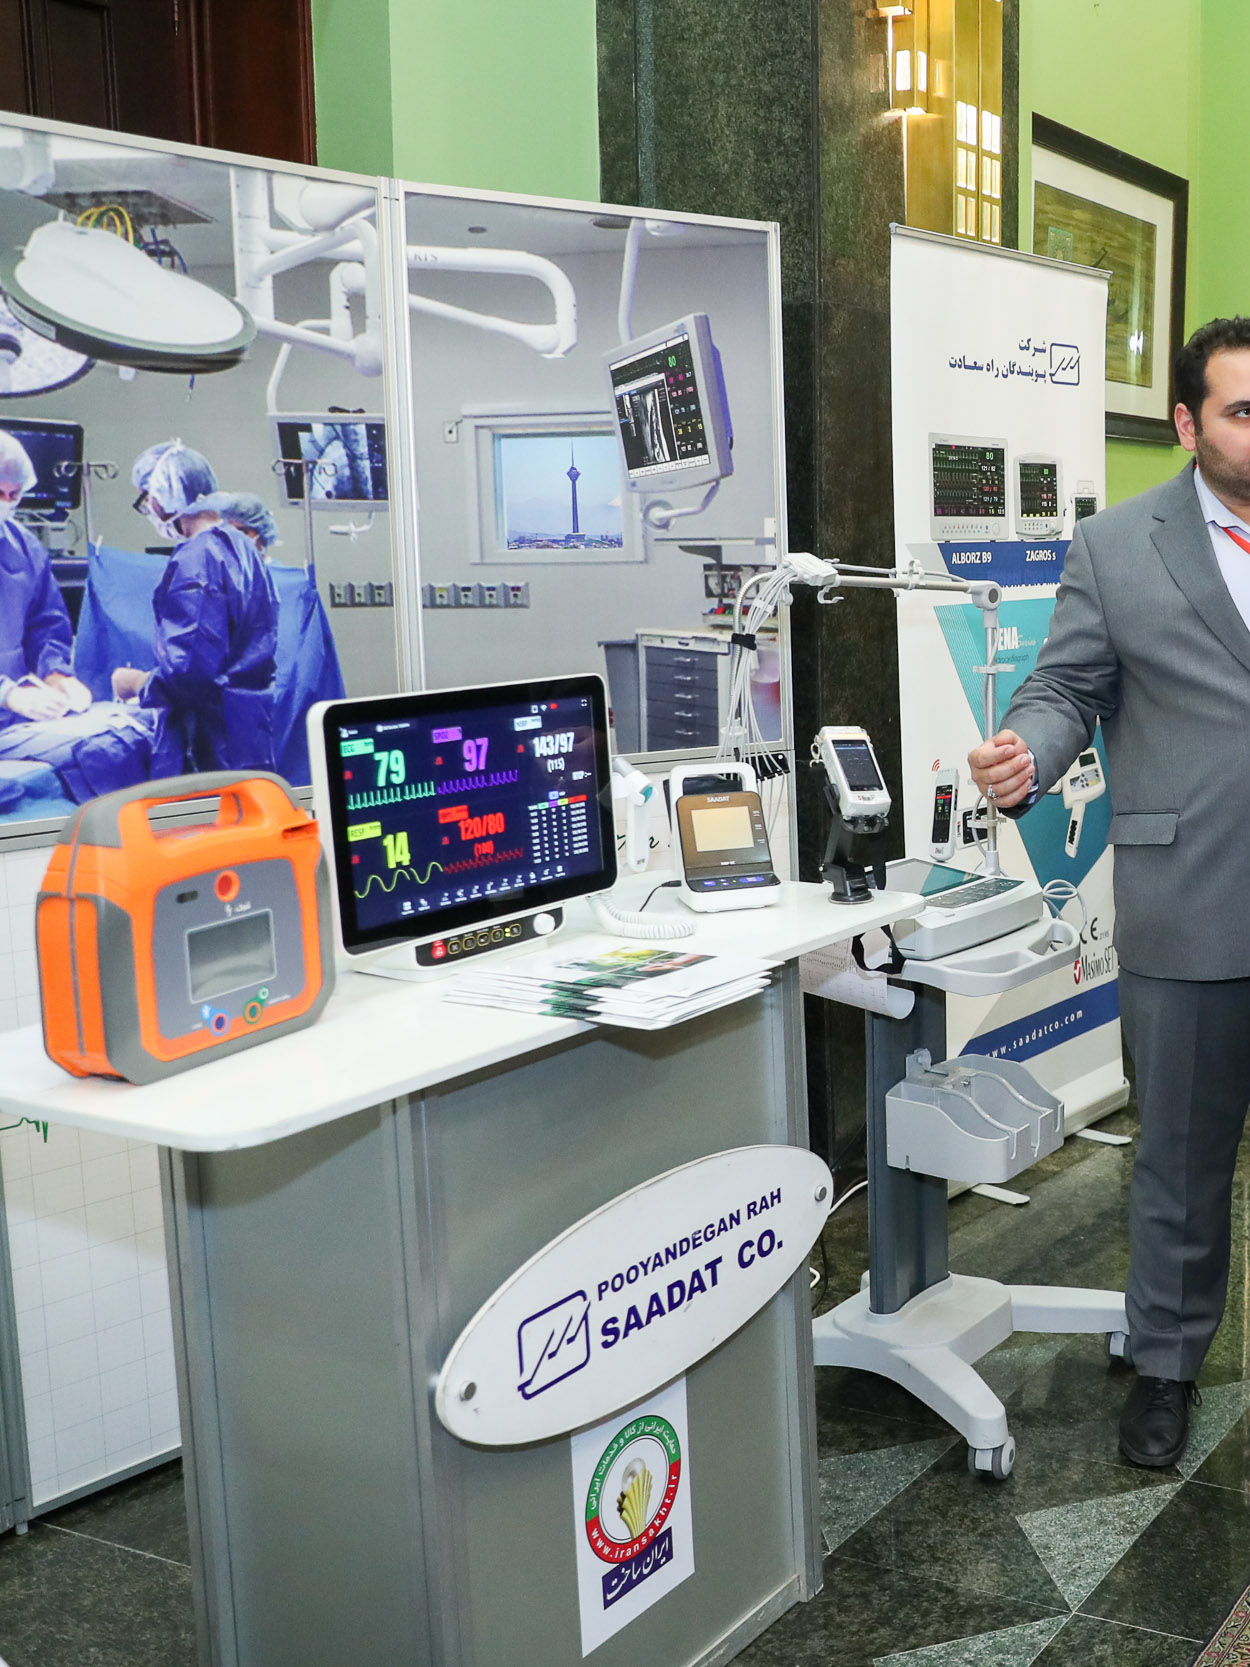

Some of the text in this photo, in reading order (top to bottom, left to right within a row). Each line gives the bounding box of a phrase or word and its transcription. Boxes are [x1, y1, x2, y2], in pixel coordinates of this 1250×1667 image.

[1018, 337, 1046, 356] شرکت
[948, 354, 1046, 384] پویندگان راه سعادت
[951, 552, 992, 565] ALBORZ B9
[1025, 550, 1052, 562] ZAGROS
[343, 744, 355, 753] ECG
[463, 737, 489, 772] 97
[533, 732, 575, 757] 143/97
[373, 749, 406, 787] 79
[707, 795, 730, 803] SAADAT
[458, 812, 506, 841] 120/80
[382, 831, 411, 869] 14
[598, 1187, 782, 1302] POOYANDEGAN RAH
[601, 1229, 784, 1349] SAADAT CO.
[589, 1421, 676, 1510] حمایت ایرانی از کالا و خدمات ایرانی
[606, 1536, 669, 1601] ایران ساخت
